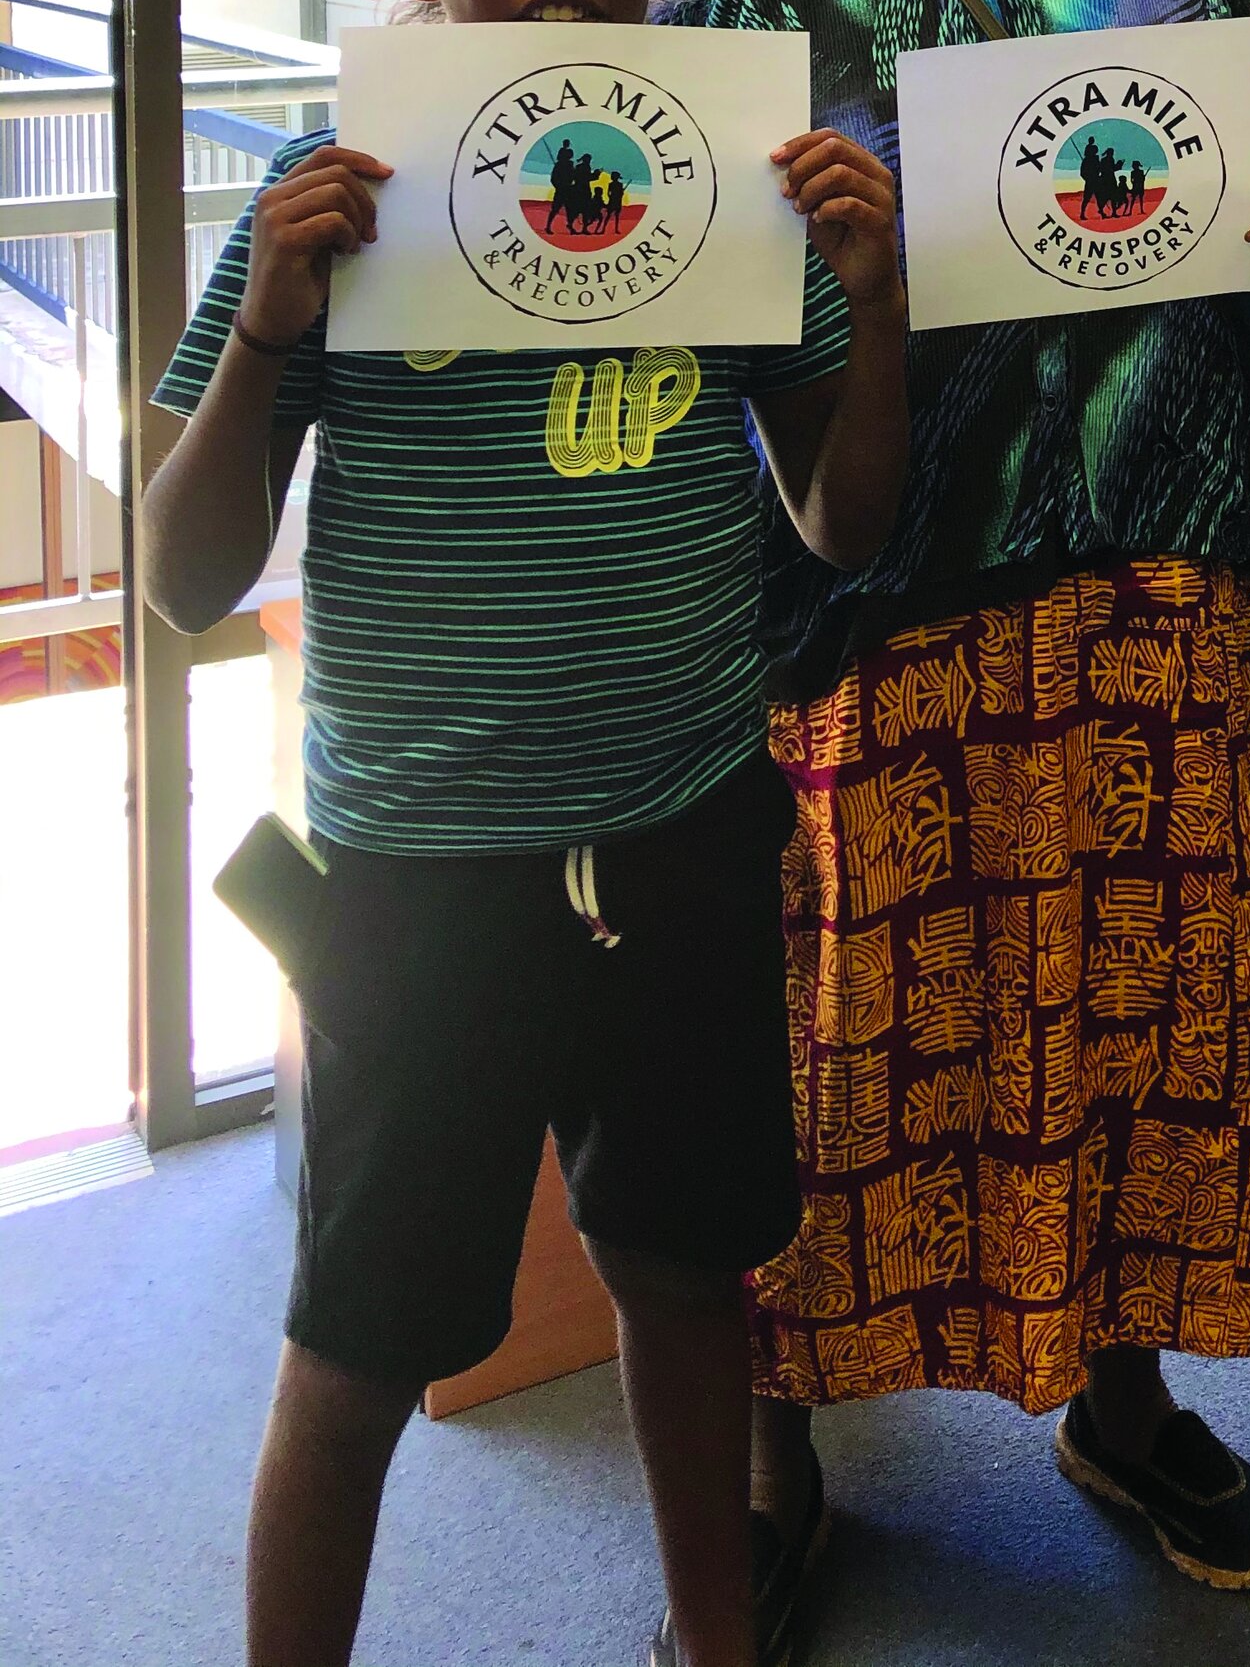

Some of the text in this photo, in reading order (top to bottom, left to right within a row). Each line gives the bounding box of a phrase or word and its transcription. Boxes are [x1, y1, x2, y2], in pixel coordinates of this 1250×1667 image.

[472, 77, 694, 185] XTRA MILE
[1015, 80, 1204, 173] XTRA MILE
[488, 219, 676, 286] TRANSPORT
[1034, 221, 1195, 277] & RECOVERY
[1036, 200, 1189, 259] TRANSPORT
[483, 247, 680, 308] & RECOVERY
